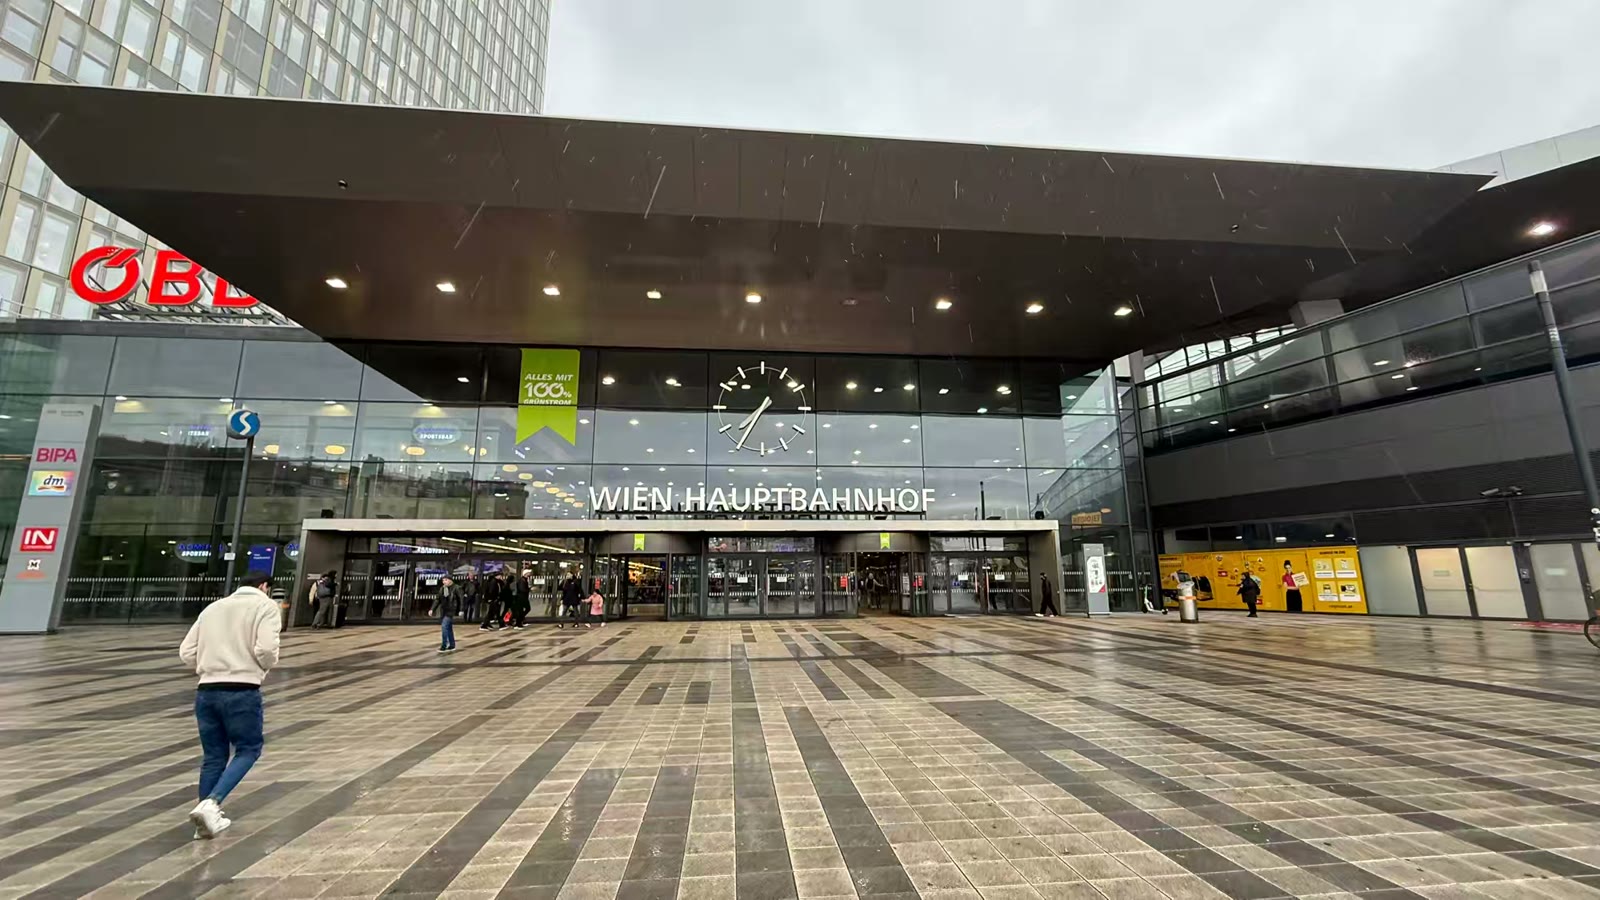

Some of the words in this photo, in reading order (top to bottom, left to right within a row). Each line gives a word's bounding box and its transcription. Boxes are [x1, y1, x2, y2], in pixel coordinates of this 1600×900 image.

[525, 373, 553, 381] ALLES
[523, 382, 572, 398] 100%
[36, 447, 77, 463] BIPA
[43, 475, 64, 486] dm
[589, 486, 672, 511] WIEN
[685, 487, 935, 512] HAUPTBAHNHOF
[24, 530, 55, 545] IN
